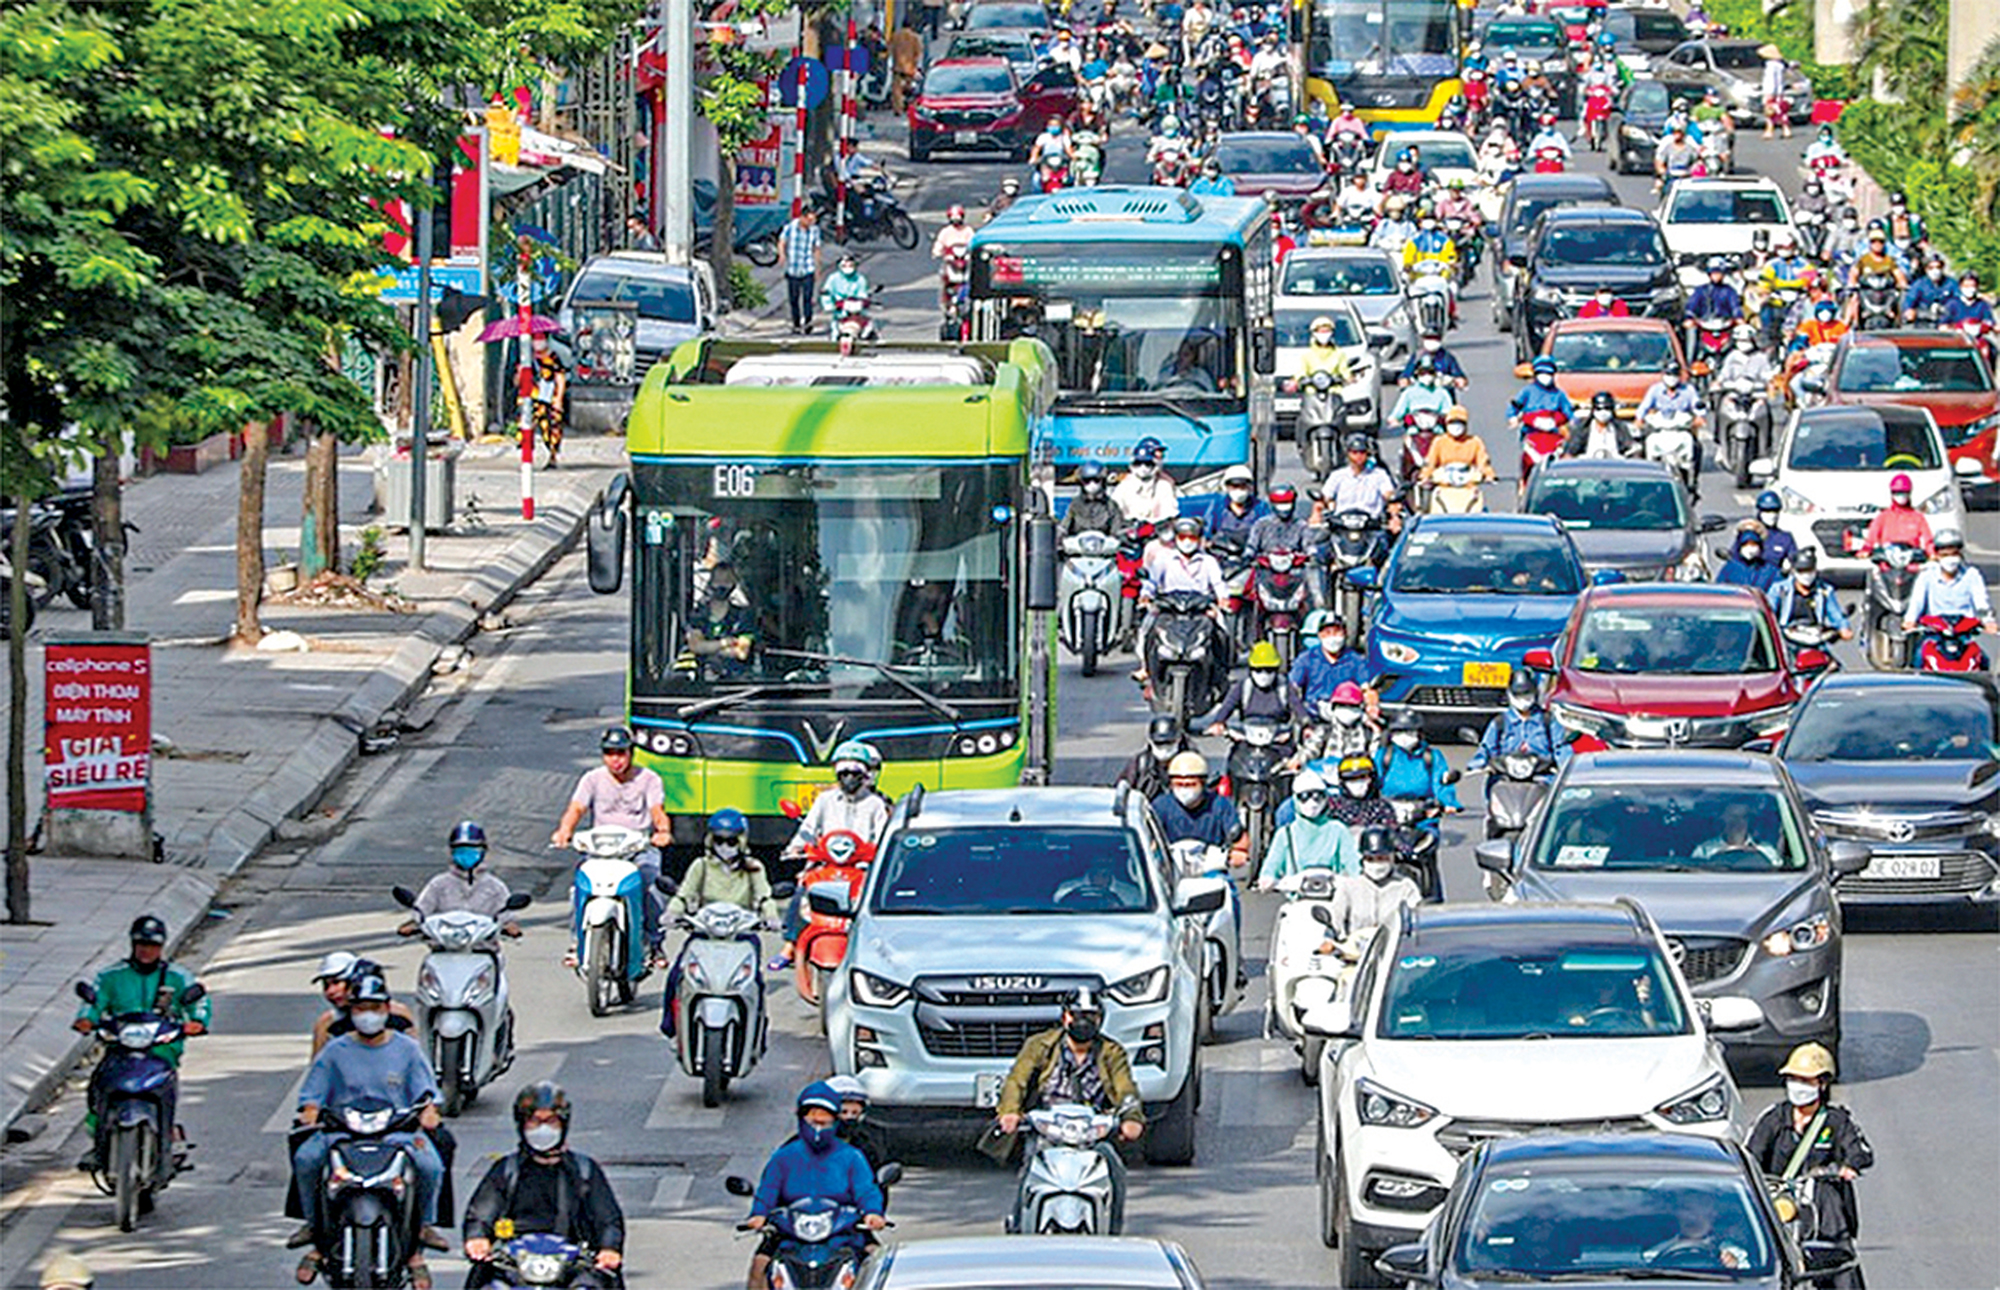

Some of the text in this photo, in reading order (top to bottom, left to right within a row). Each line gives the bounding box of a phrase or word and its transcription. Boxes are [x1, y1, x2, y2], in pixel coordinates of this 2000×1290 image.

[714, 464, 755, 496] E06
[53, 682, 140, 702] ĐIỆN THOẠI
[56, 706, 132, 723] MÁY TÍNH
[49, 761, 108, 787] SIÊU
[974, 976, 1041, 990] ISUZU
